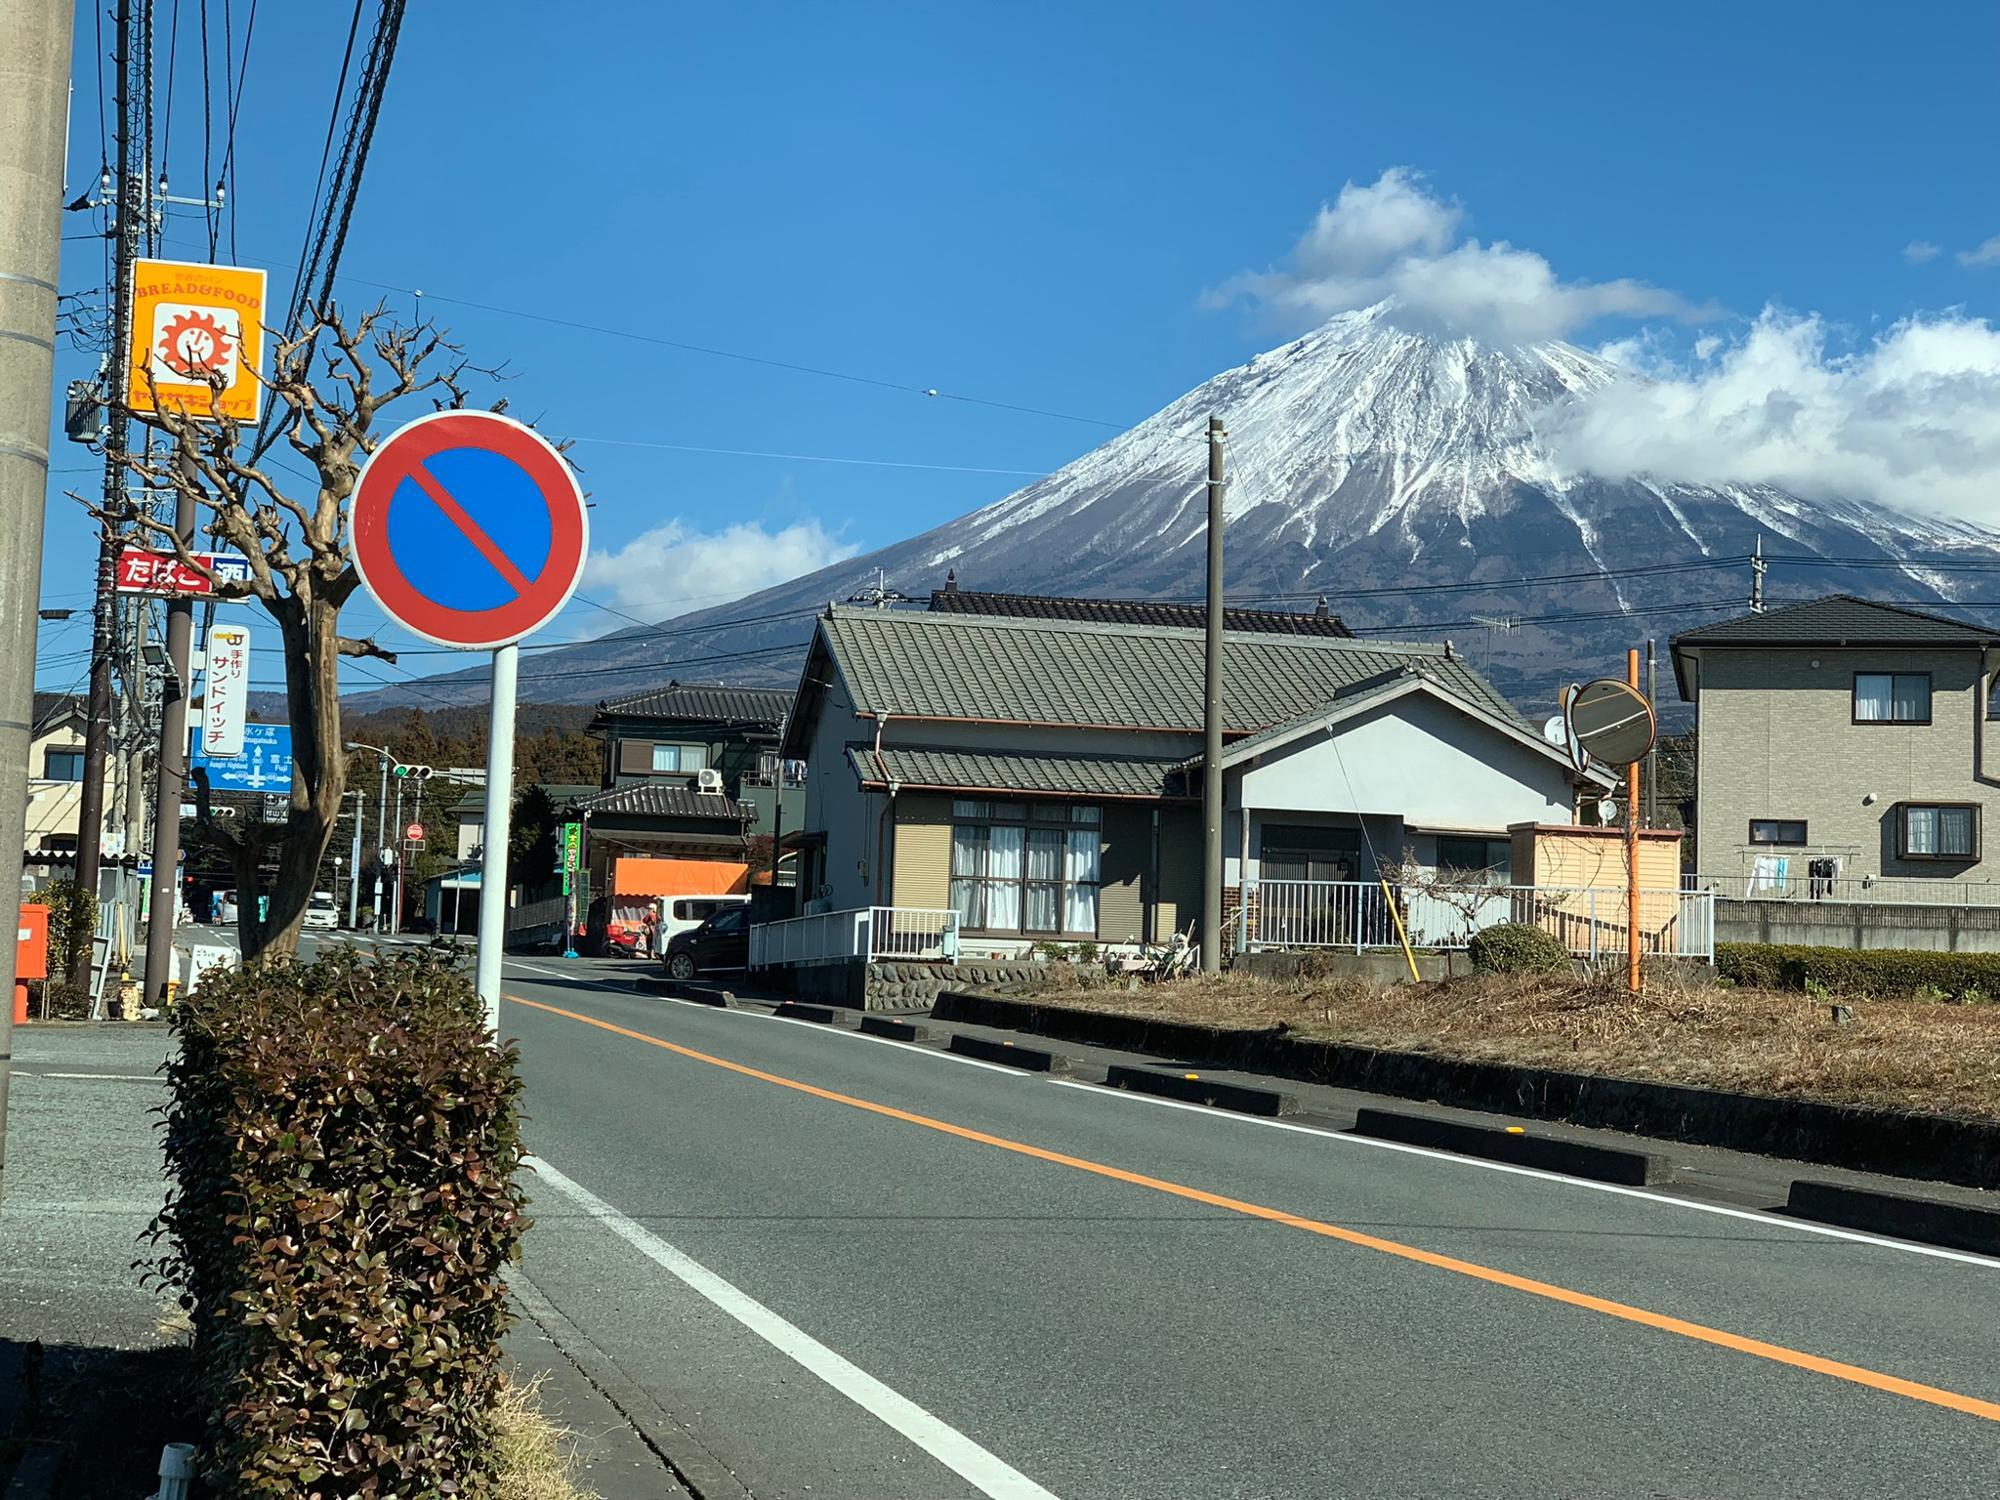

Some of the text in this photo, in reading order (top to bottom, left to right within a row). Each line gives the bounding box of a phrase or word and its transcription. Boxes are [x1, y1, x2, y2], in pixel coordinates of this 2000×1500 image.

[137, 283, 261, 310] BREAD&FOOD
[126, 557, 201, 586] たばこ
[215, 562, 245, 584] 酒
[230, 649, 243, 679] 手作り
[207, 656, 230, 744] サンドイッチ
[243, 736, 277, 745] izugatsuka
[270, 754, 292, 765] 富士
[274, 764, 288, 773] Fuji
